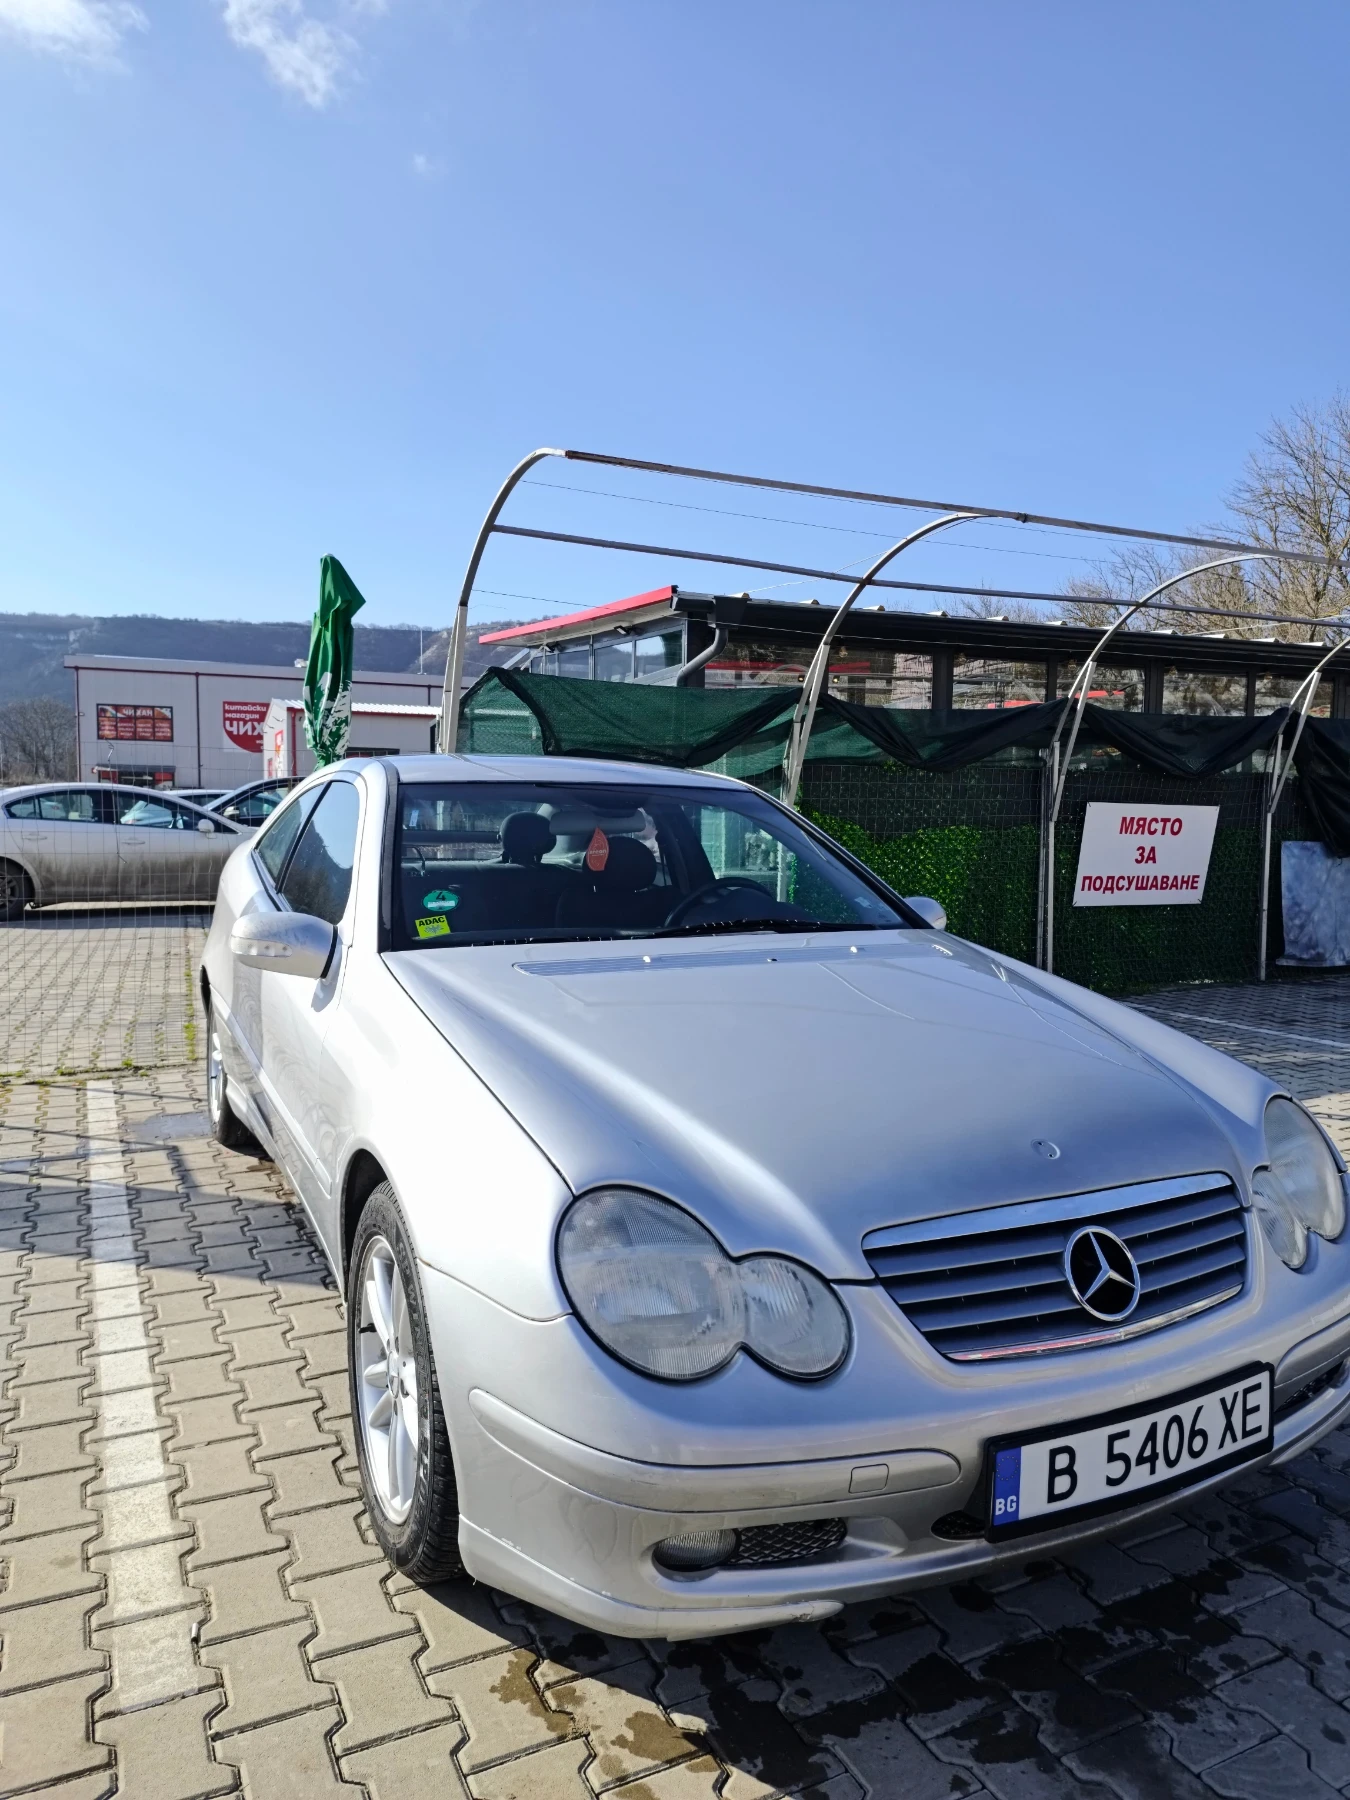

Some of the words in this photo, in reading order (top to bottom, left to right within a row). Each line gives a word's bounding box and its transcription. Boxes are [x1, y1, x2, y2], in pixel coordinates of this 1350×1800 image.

[1119, 816, 1183, 836] МЯСТО
[1134, 846, 1157, 865] ЗА
[1080, 875, 1200, 894] ПОДСУШАВАНЕ
[435, 891, 447, 901] 4
[418, 916, 446, 927] ADAC
[1047, 1444, 1078, 1504] B
[1105, 1405, 1209, 1488] 5406
[1218, 1382, 1263, 1450] XE
[995, 1495, 1017, 1517] BG
